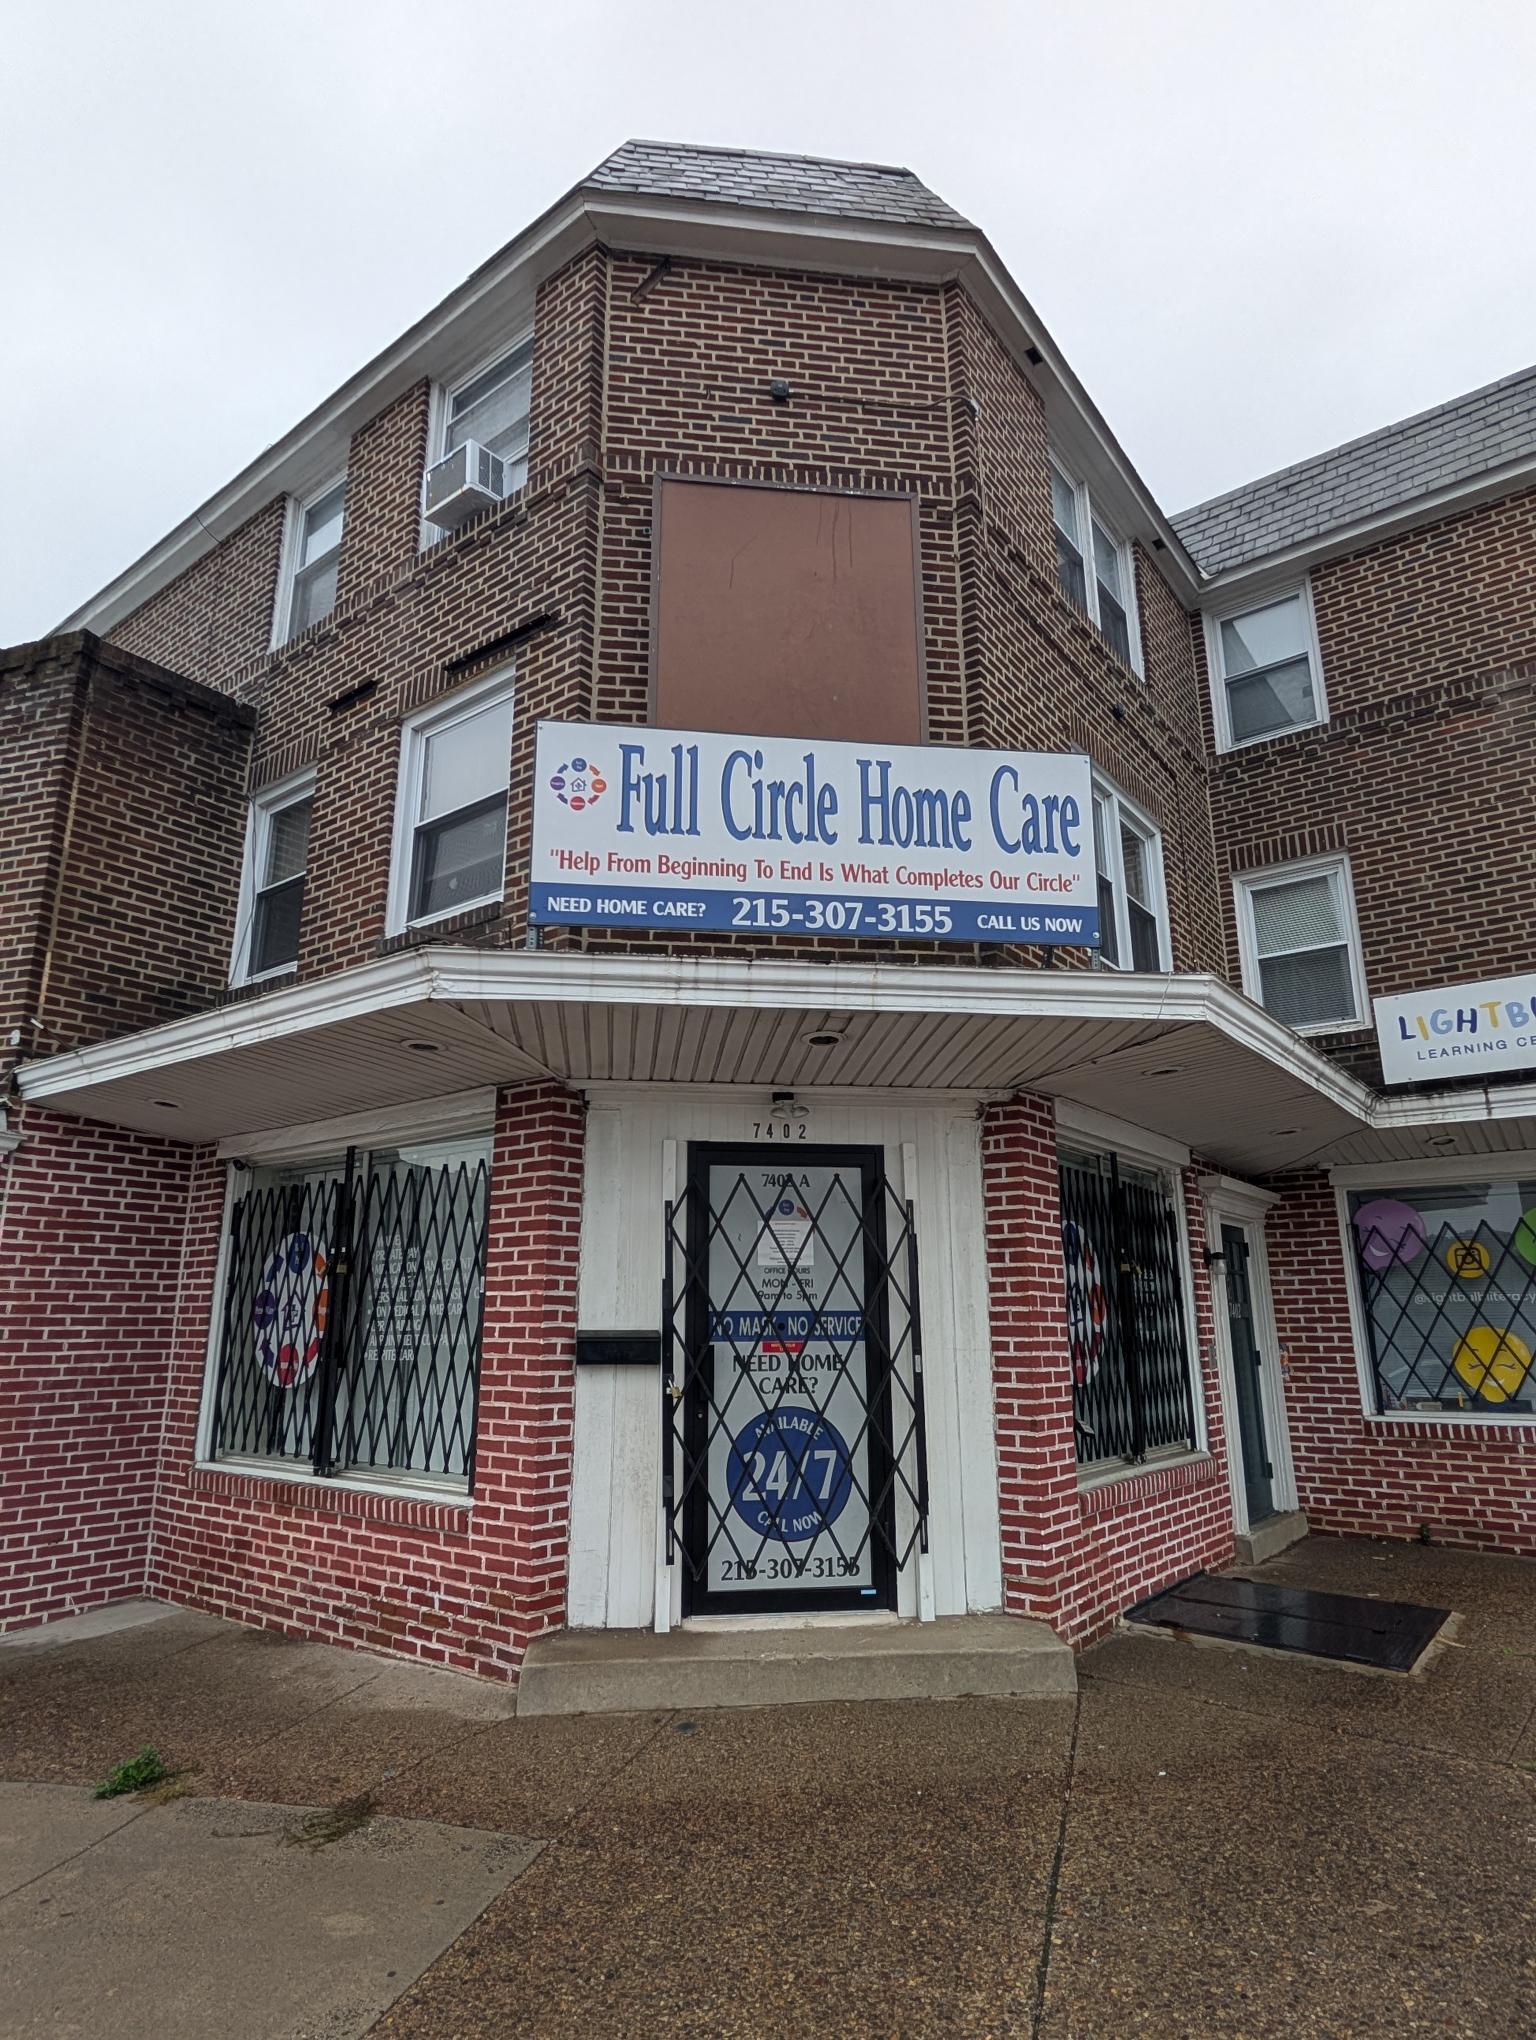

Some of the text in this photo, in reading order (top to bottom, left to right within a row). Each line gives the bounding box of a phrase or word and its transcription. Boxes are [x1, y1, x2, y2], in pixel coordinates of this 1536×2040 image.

[616, 743, 1082, 858] Full Circle Home Care
[549, 848, 1080, 893] "Help From Beginning To End Is What Completes Our Circle"
[547, 896, 1083, 935] NEED HOME CARE? 215-307-3155 CALL US NOW
[1416, 1038, 1508, 1061] LEARNING
[752, 1122, 807, 1140] 7402
[799, 1173, 811, 1188] A
[763, 1267, 811, 1275] OFFICE OURS
[758, 1290, 779, 1300] 9am
[783, 1291, 793, 1300] to
[788, 1316, 809, 1336] NO
[759, 1377, 818, 1395] CARE?
[755, 1416, 824, 1440] AVILABLE
[742, 1449, 837, 1501] 24/7
[792, 1511, 823, 1532] NOW
